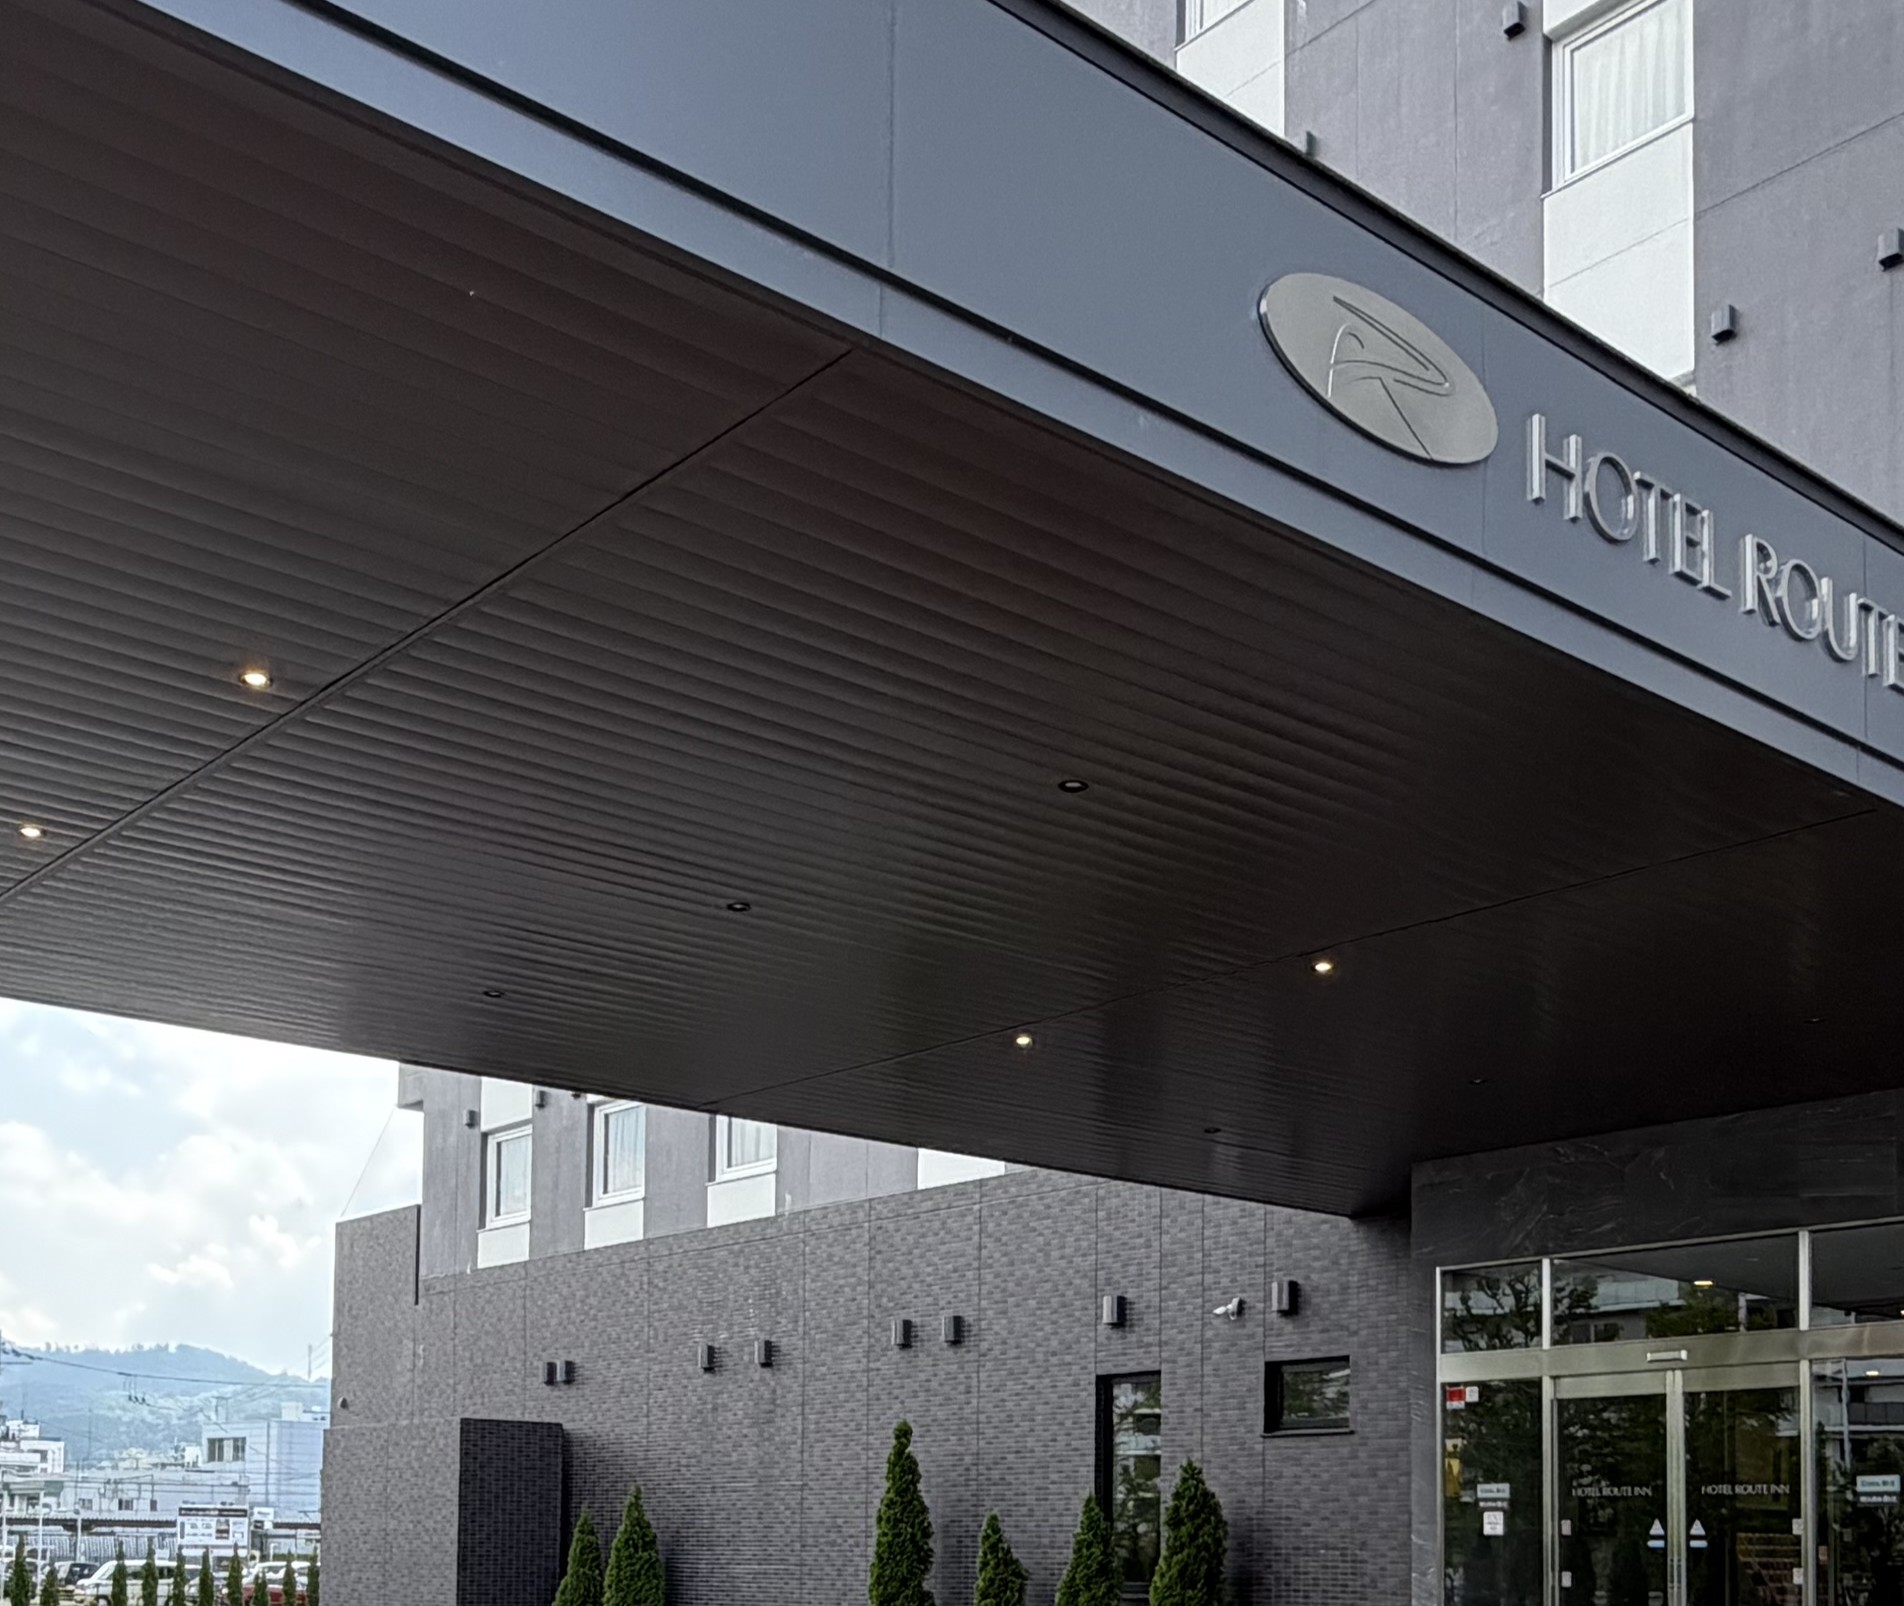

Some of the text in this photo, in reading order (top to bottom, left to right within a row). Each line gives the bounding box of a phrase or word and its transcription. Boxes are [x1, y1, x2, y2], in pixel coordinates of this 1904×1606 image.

[1526, 413, 1732, 599] HOTEL
[1572, 1486, 1652, 1498] HOTEL ROUTE INN
[1701, 1483, 1791, 1495] HOTEL ROUTE INN
